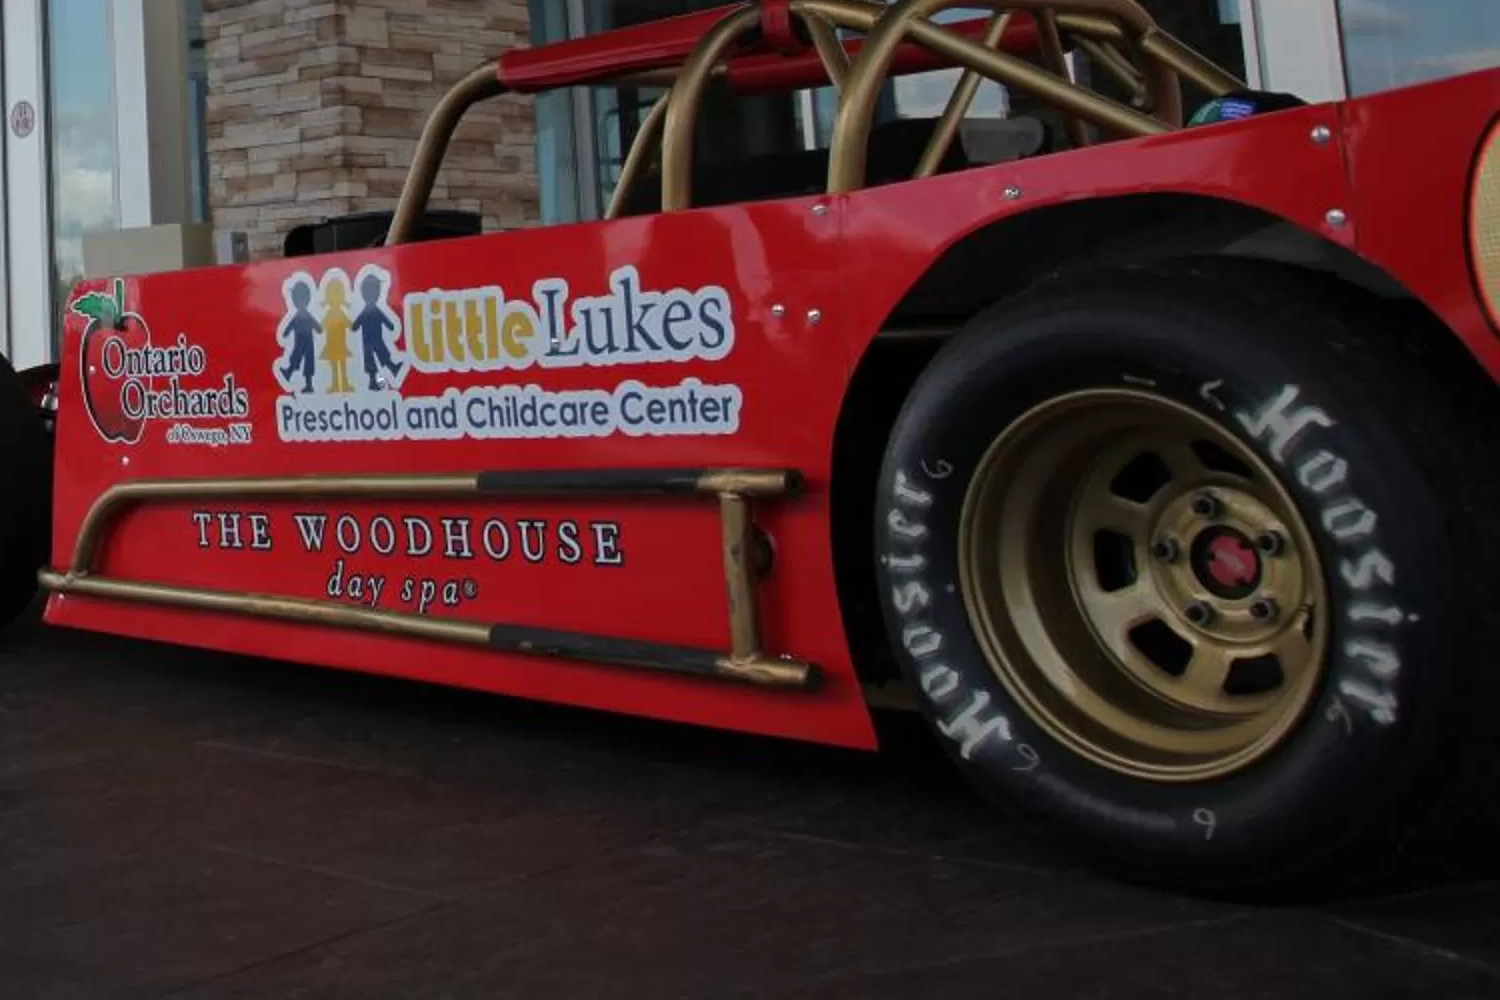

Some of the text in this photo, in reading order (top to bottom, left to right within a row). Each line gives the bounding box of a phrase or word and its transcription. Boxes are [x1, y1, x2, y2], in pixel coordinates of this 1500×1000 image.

[541, 276, 726, 357] Lukes
[102, 333, 205, 379] Ontario
[120, 373, 249, 420] Orchards
[281, 389, 733, 433] Preschool and Childcare Center
[193, 512, 623, 565] THE WOODHOUSE
[327, 560, 385, 608] day
